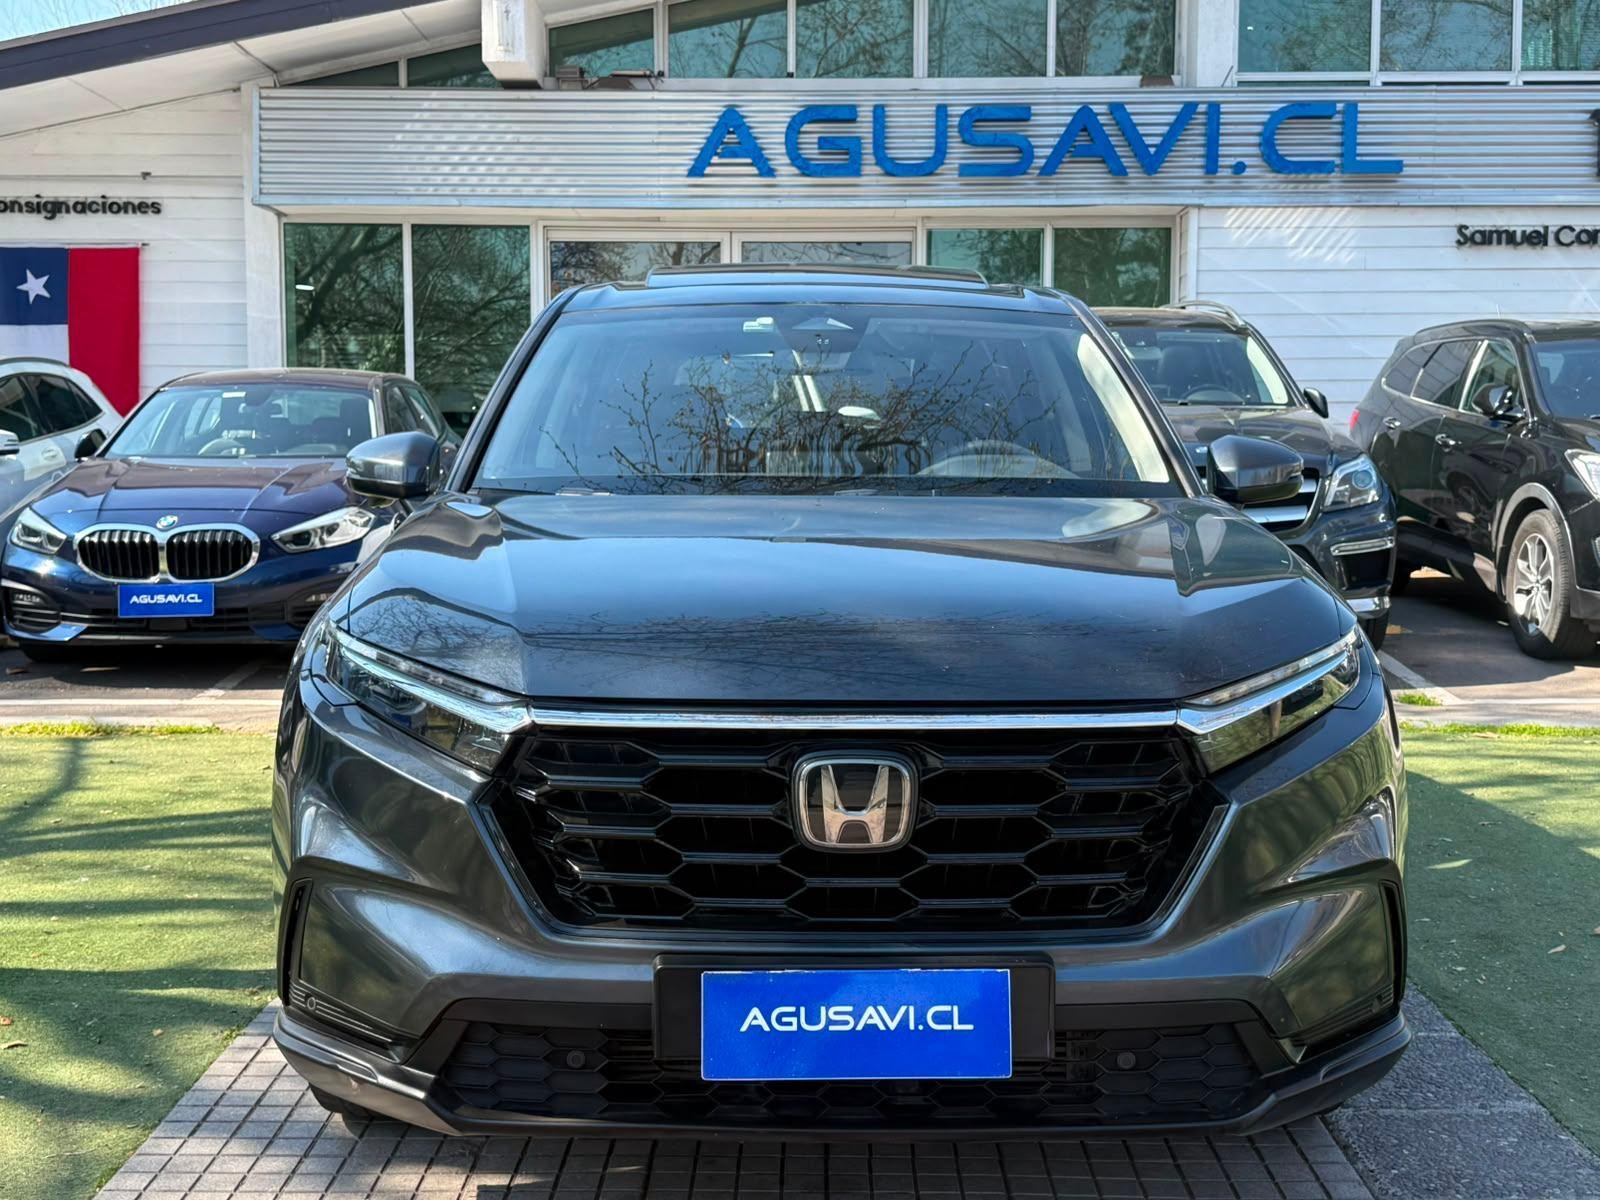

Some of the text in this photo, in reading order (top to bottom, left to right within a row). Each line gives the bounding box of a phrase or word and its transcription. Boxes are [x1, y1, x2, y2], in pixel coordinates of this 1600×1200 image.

[687, 102, 1404, 178] AGUSAVI.CL
[1456, 225, 1549, 247] Samuel
[130, 593, 202, 604] AGUSAVI.CL
[739, 1004, 974, 1032] AGUSAVI.CL
